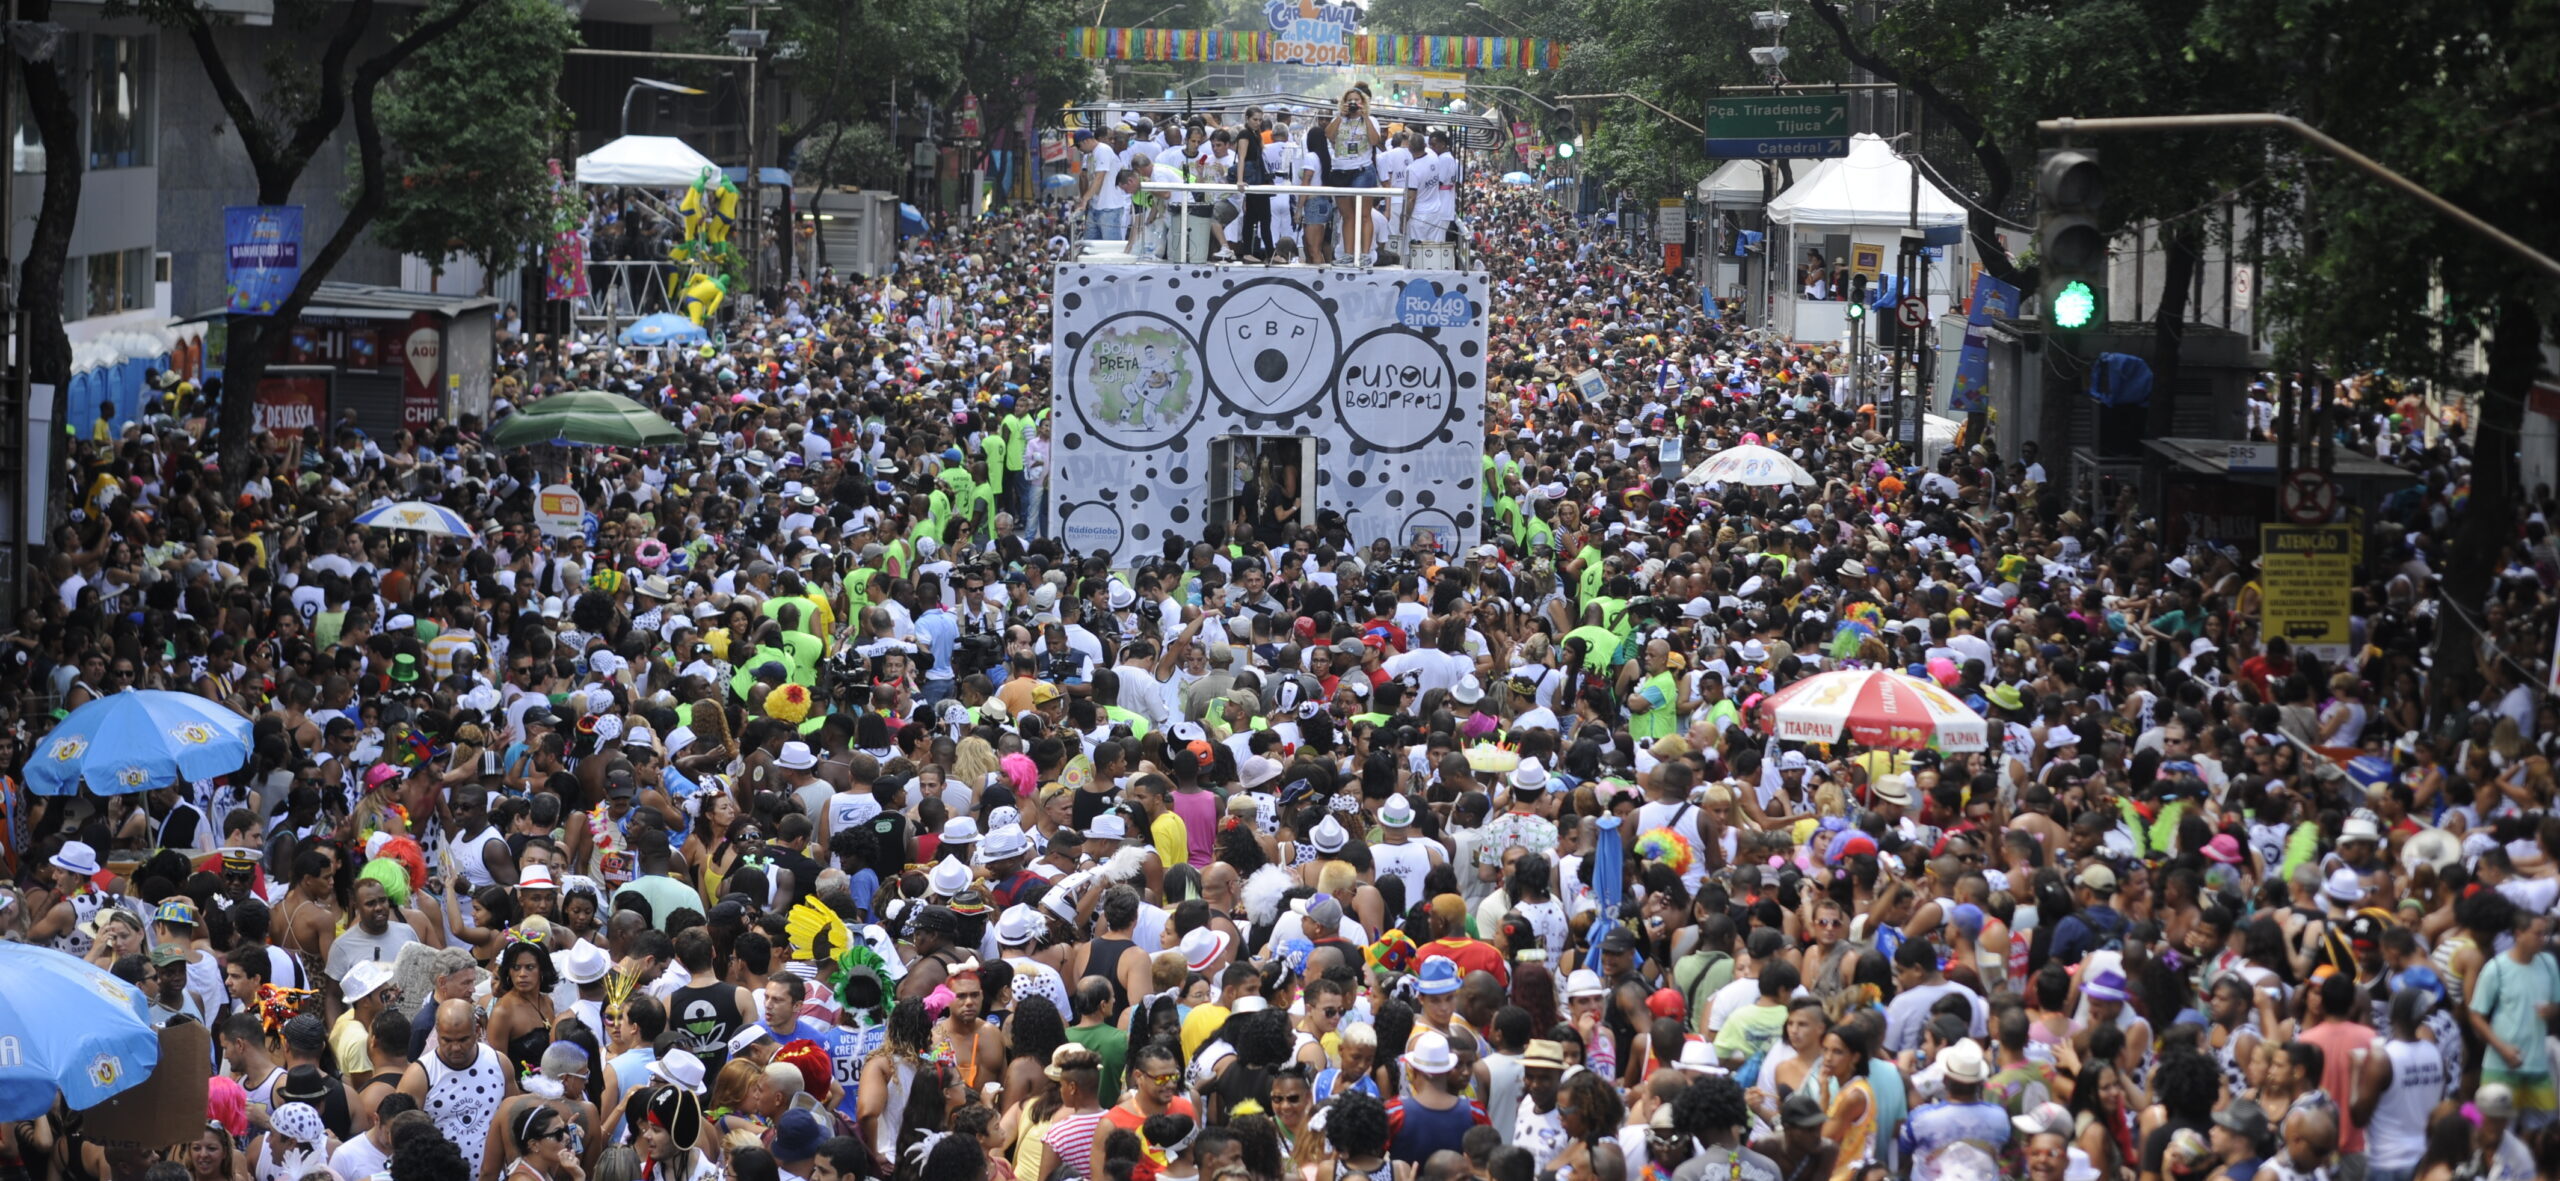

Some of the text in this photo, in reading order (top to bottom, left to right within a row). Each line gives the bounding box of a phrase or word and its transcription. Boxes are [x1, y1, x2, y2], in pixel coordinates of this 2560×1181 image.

[1283, 20, 1340, 44] de RUA
[1275, 42, 1349, 64] Rio 2014
[1708, 104, 1821, 119] Pça. Tiradentes
[1776, 120, 1820, 133] Tijuca
[1758, 143, 1820, 154] Catedral
[1405, 296, 1465, 316] Rio 449
[1101, 342, 1135, 355] BOLA
[1099, 356, 1140, 371] PRETA
[2229, 446, 2256, 459] BRS
[2276, 530, 2338, 550] ATENÇÃO
[1879, 680, 1897, 714] ITAIPAVA
[1785, 720, 1833, 738] ITAIPAVA
